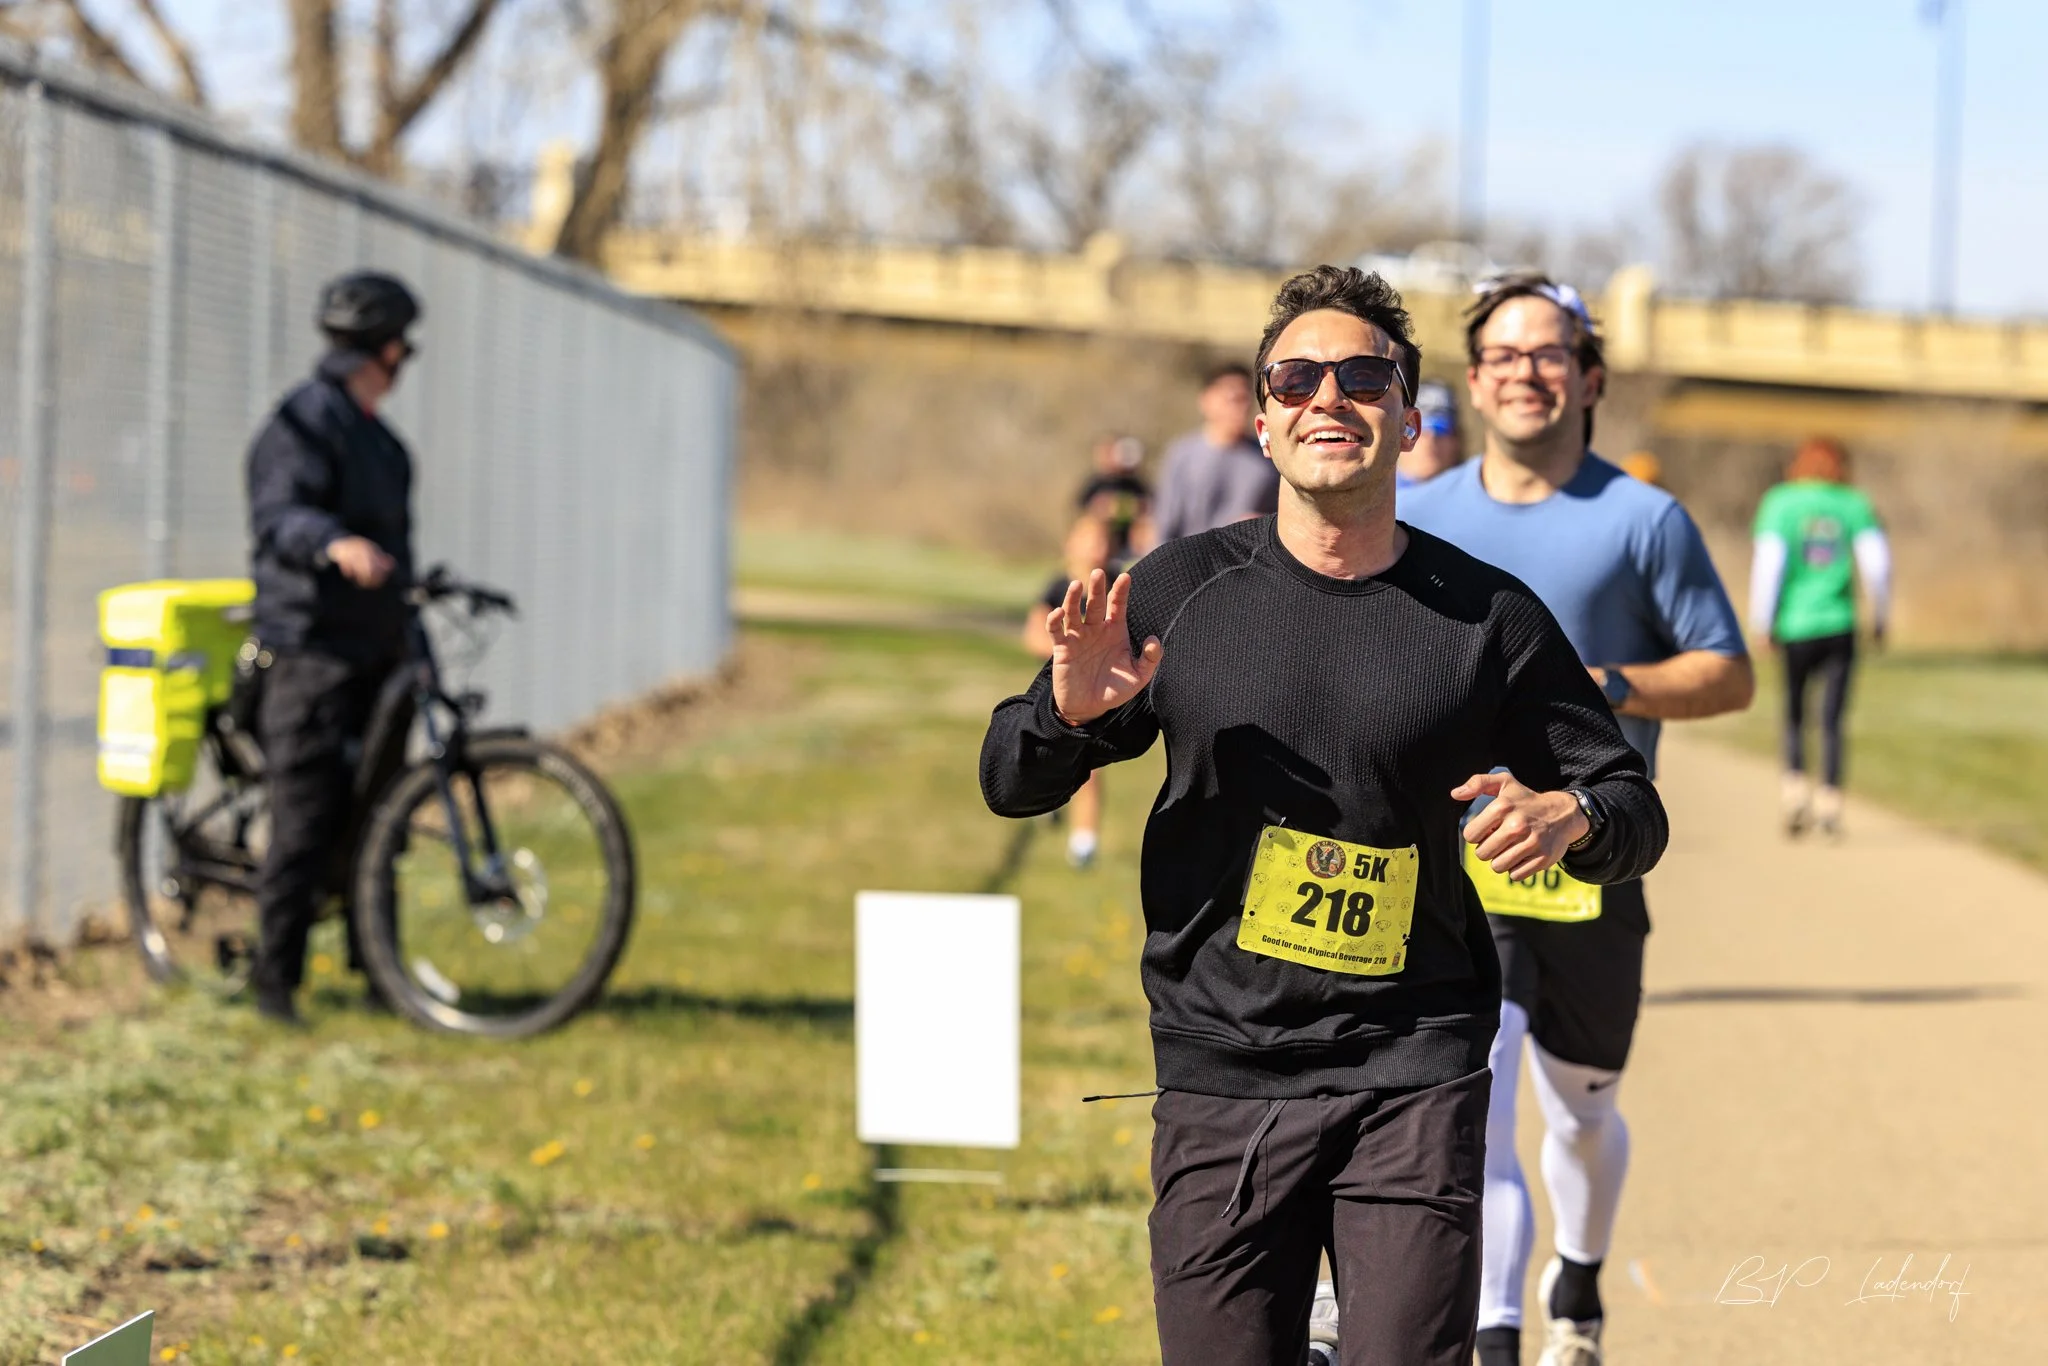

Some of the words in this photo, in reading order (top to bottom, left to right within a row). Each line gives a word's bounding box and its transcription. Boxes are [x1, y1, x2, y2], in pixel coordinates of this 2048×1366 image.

[1353, 853, 1390, 883] 5K
[1290, 881, 1375, 938] 218
[1262, 934, 1281, 946] Good
[1281, 940, 1292, 949] for
[1293, 943, 1307, 953] one
[1308, 946, 1338, 960] Atypical
[1339, 952, 1373, 964] Beverage
[1373, 956, 1387, 965] 218
